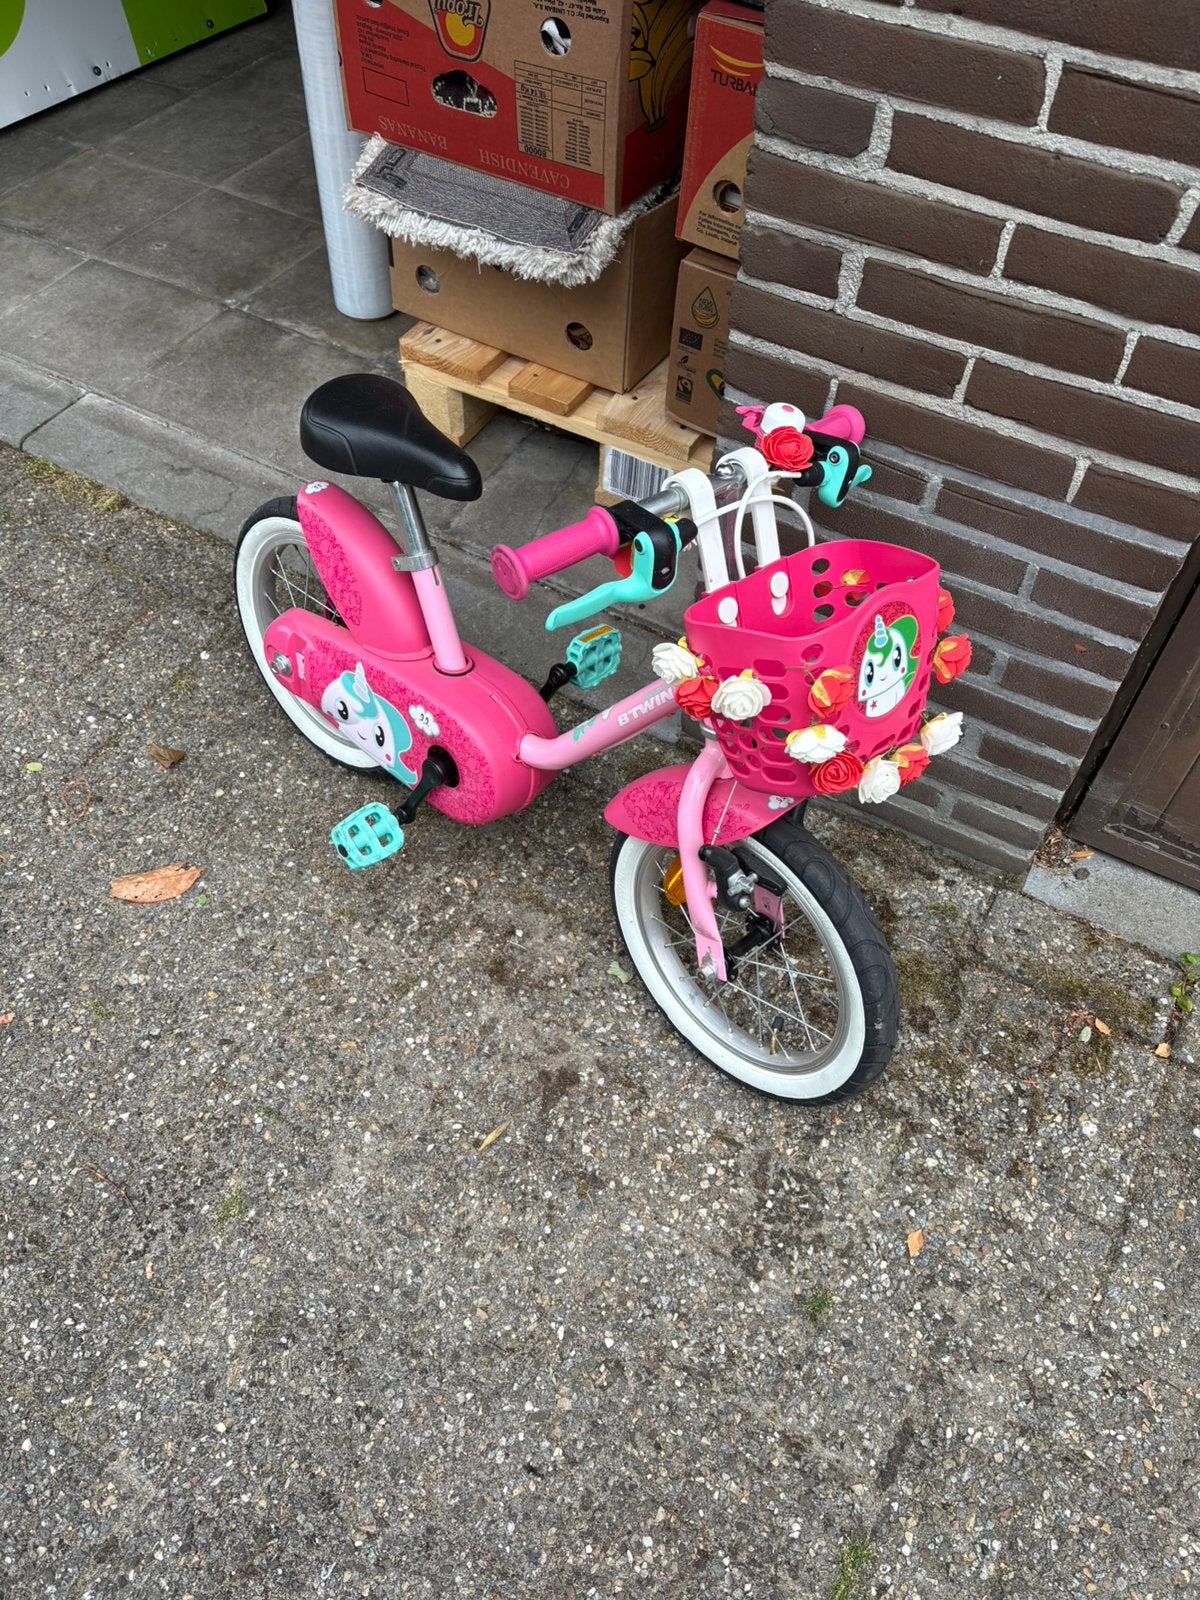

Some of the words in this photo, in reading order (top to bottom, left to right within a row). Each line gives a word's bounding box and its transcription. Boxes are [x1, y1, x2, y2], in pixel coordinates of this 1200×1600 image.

[586, 13, 610, 24] Exported
[378, 115, 448, 150] BANANAS
[479, 148, 570, 189] CAVENDISH
